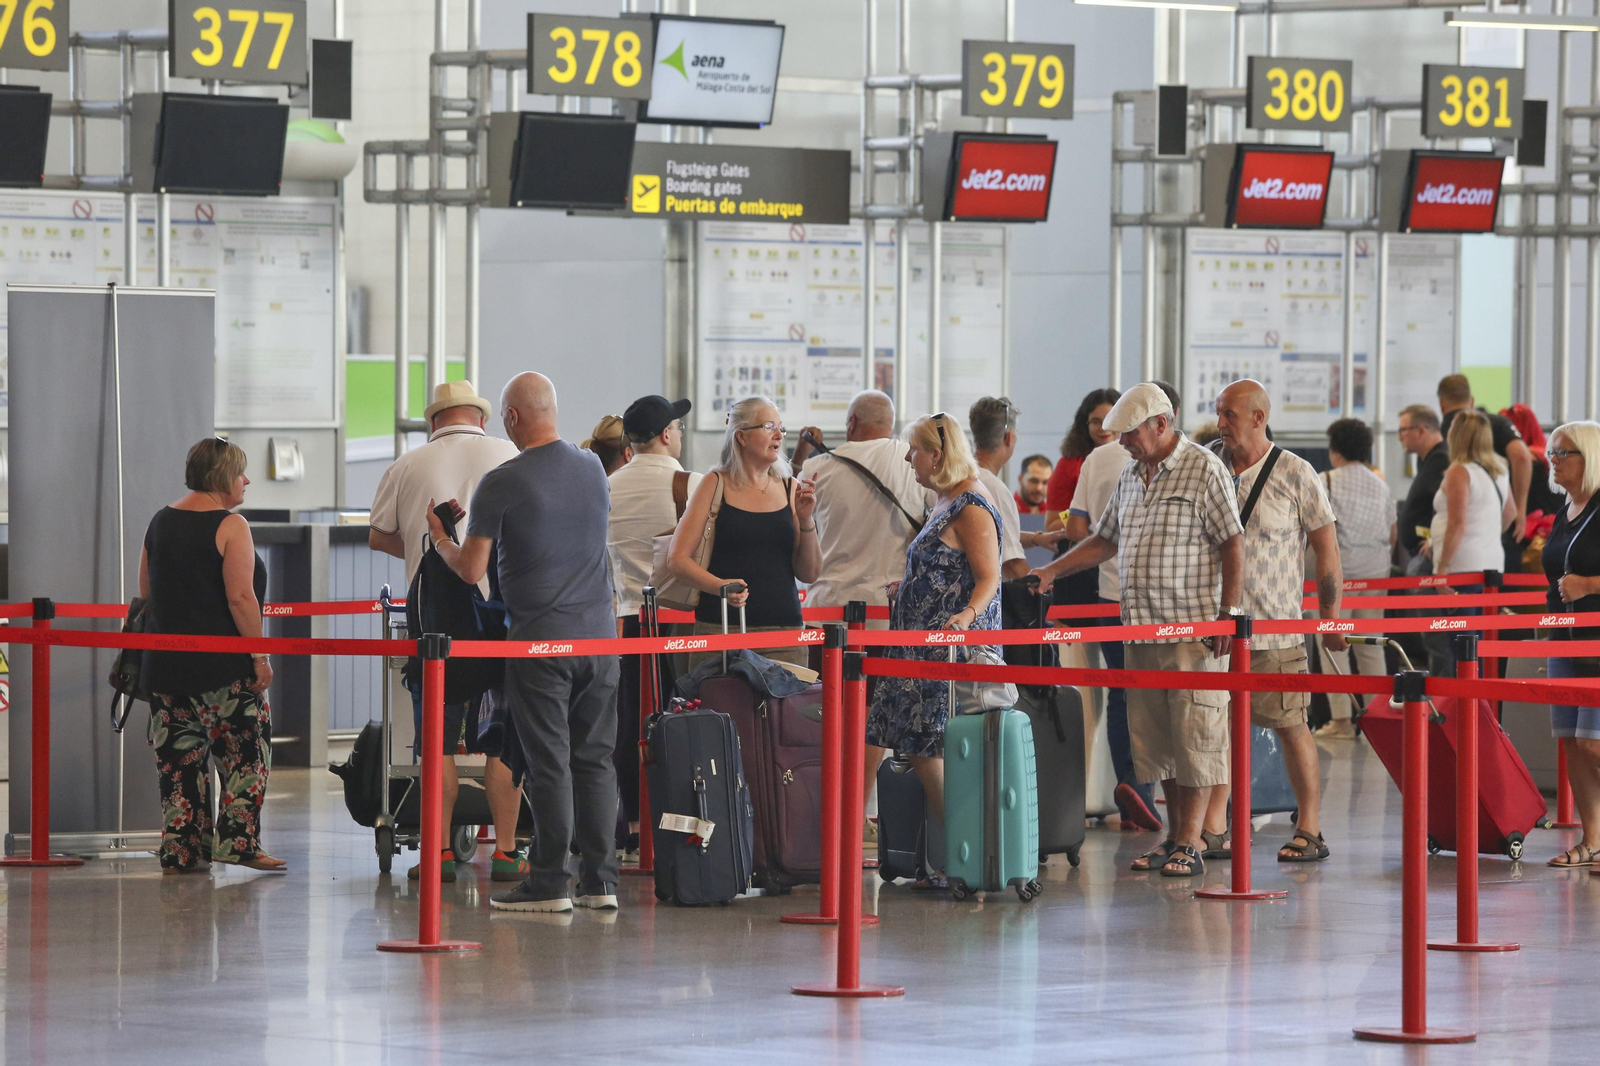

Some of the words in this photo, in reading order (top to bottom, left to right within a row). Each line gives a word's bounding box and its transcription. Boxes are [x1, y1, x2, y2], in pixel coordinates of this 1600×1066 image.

[191, 6, 294, 70] 377
[548, 26, 643, 88] 378
[691, 54, 725, 68] aena
[697, 71, 740, 83] Aeropuerto
[742, 73, 750, 82] de
[980, 52, 1065, 109] 379
[1263, 67, 1344, 122] 380
[1438, 75, 1512, 128] 381
[666, 160, 718, 178] Flugsteige
[721, 162, 750, 178] Gates
[666, 178, 711, 196] Boarding
[714, 181, 742, 197] gates
[666, 195, 716, 214] Puertas
[719, 197, 736, 214] de
[739, 198, 804, 219] embarque
[263, 605, 293, 615] t2.com
